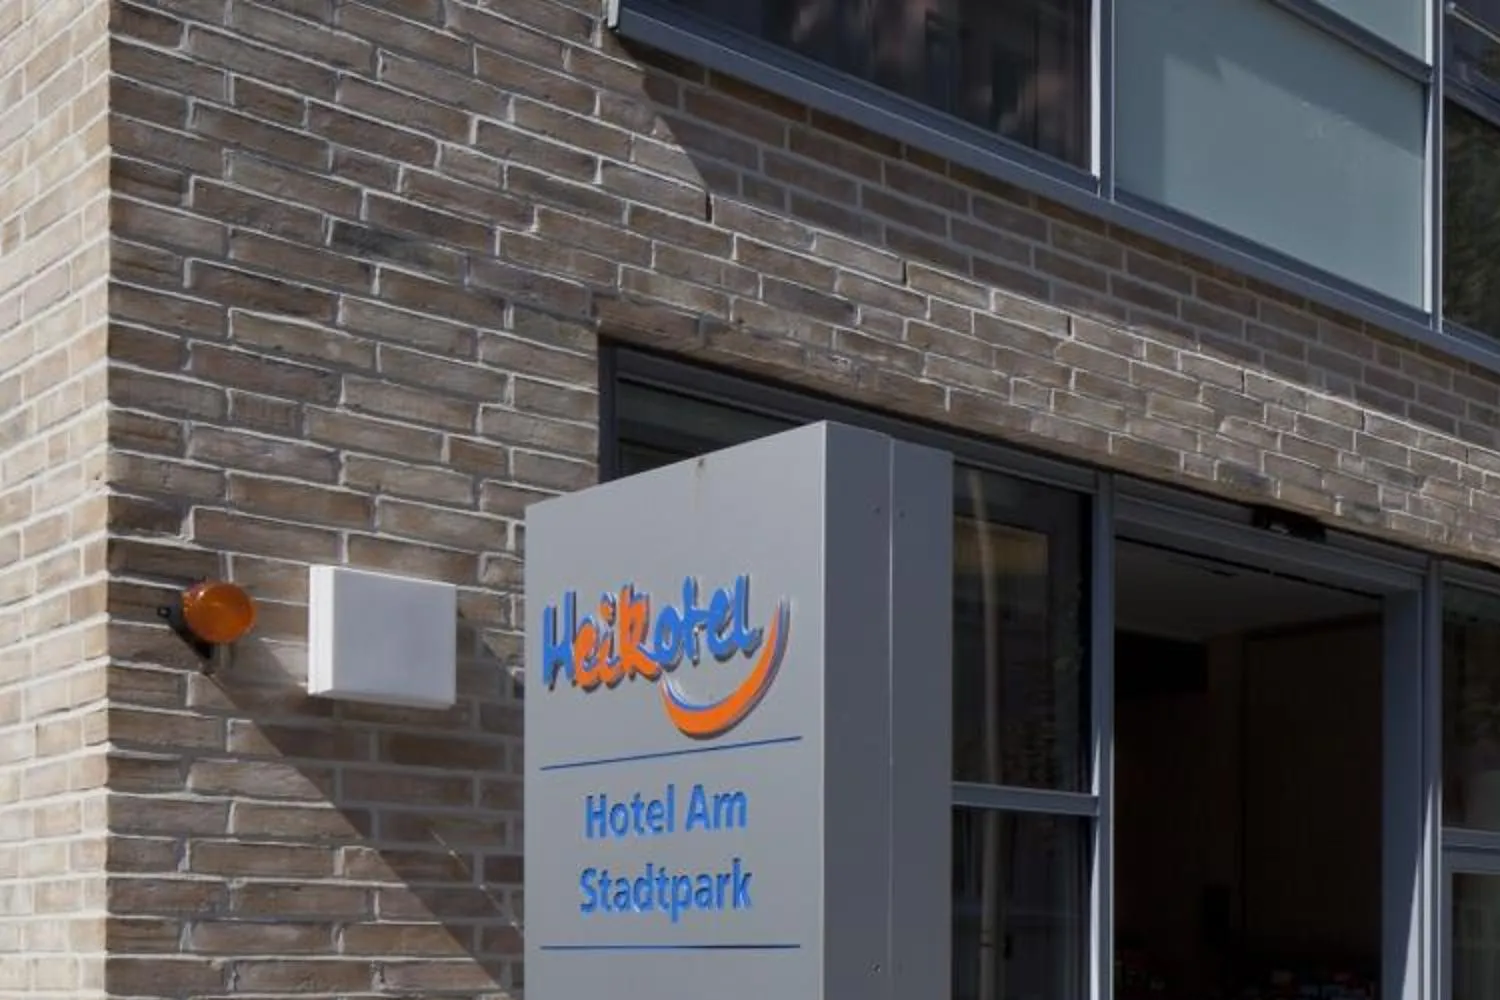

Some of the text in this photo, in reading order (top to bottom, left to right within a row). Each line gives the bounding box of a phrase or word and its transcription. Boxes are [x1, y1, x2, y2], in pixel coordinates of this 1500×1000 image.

[541, 574, 765, 693] Heikotel
[584, 783, 748, 840] Hotel Am
[579, 857, 753, 923] Stadtpark
